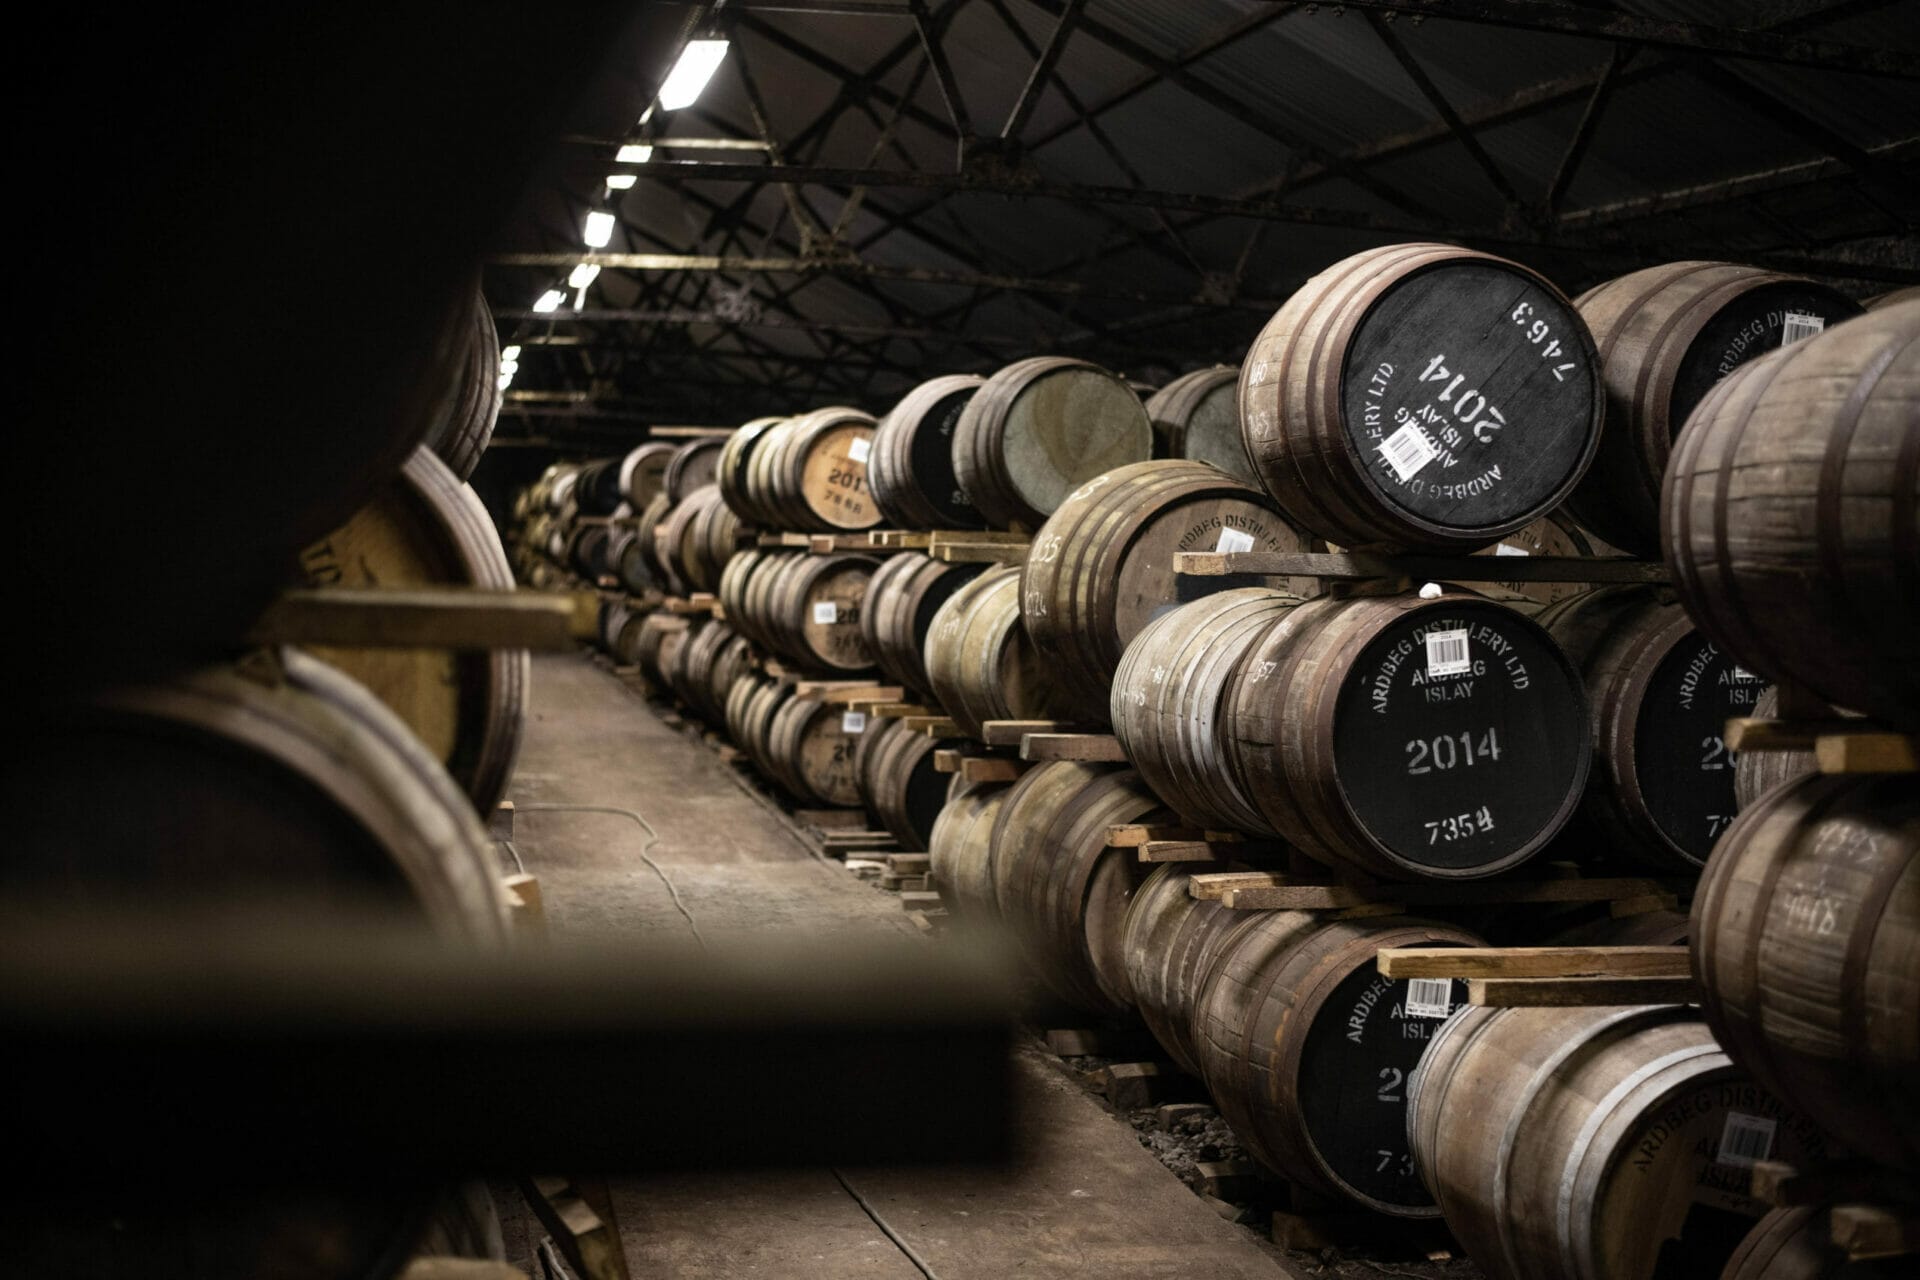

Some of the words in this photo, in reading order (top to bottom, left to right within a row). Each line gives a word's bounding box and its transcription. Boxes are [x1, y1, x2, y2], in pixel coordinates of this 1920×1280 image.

[1511, 302, 1576, 382] 7463
[1716, 318, 1765, 383] RDBEG
[1418, 354, 1507, 444] 2014
[1417, 404, 1463, 449] ISLAY
[828, 467, 866, 495] 201
[1429, 463, 1503, 500] ARDBEG
[1178, 514, 1222, 552] RDBEG
[1373, 639, 1413, 714] ARDBEG
[1504, 656, 1530, 690] LTD
[1425, 681, 1474, 703] ISLAY
[1405, 727, 1502, 775] 2014
[1701, 736, 1736, 771] 2
[1705, 814, 1736, 838] 7
[1633, 1090, 1713, 1174] ARDBEG
